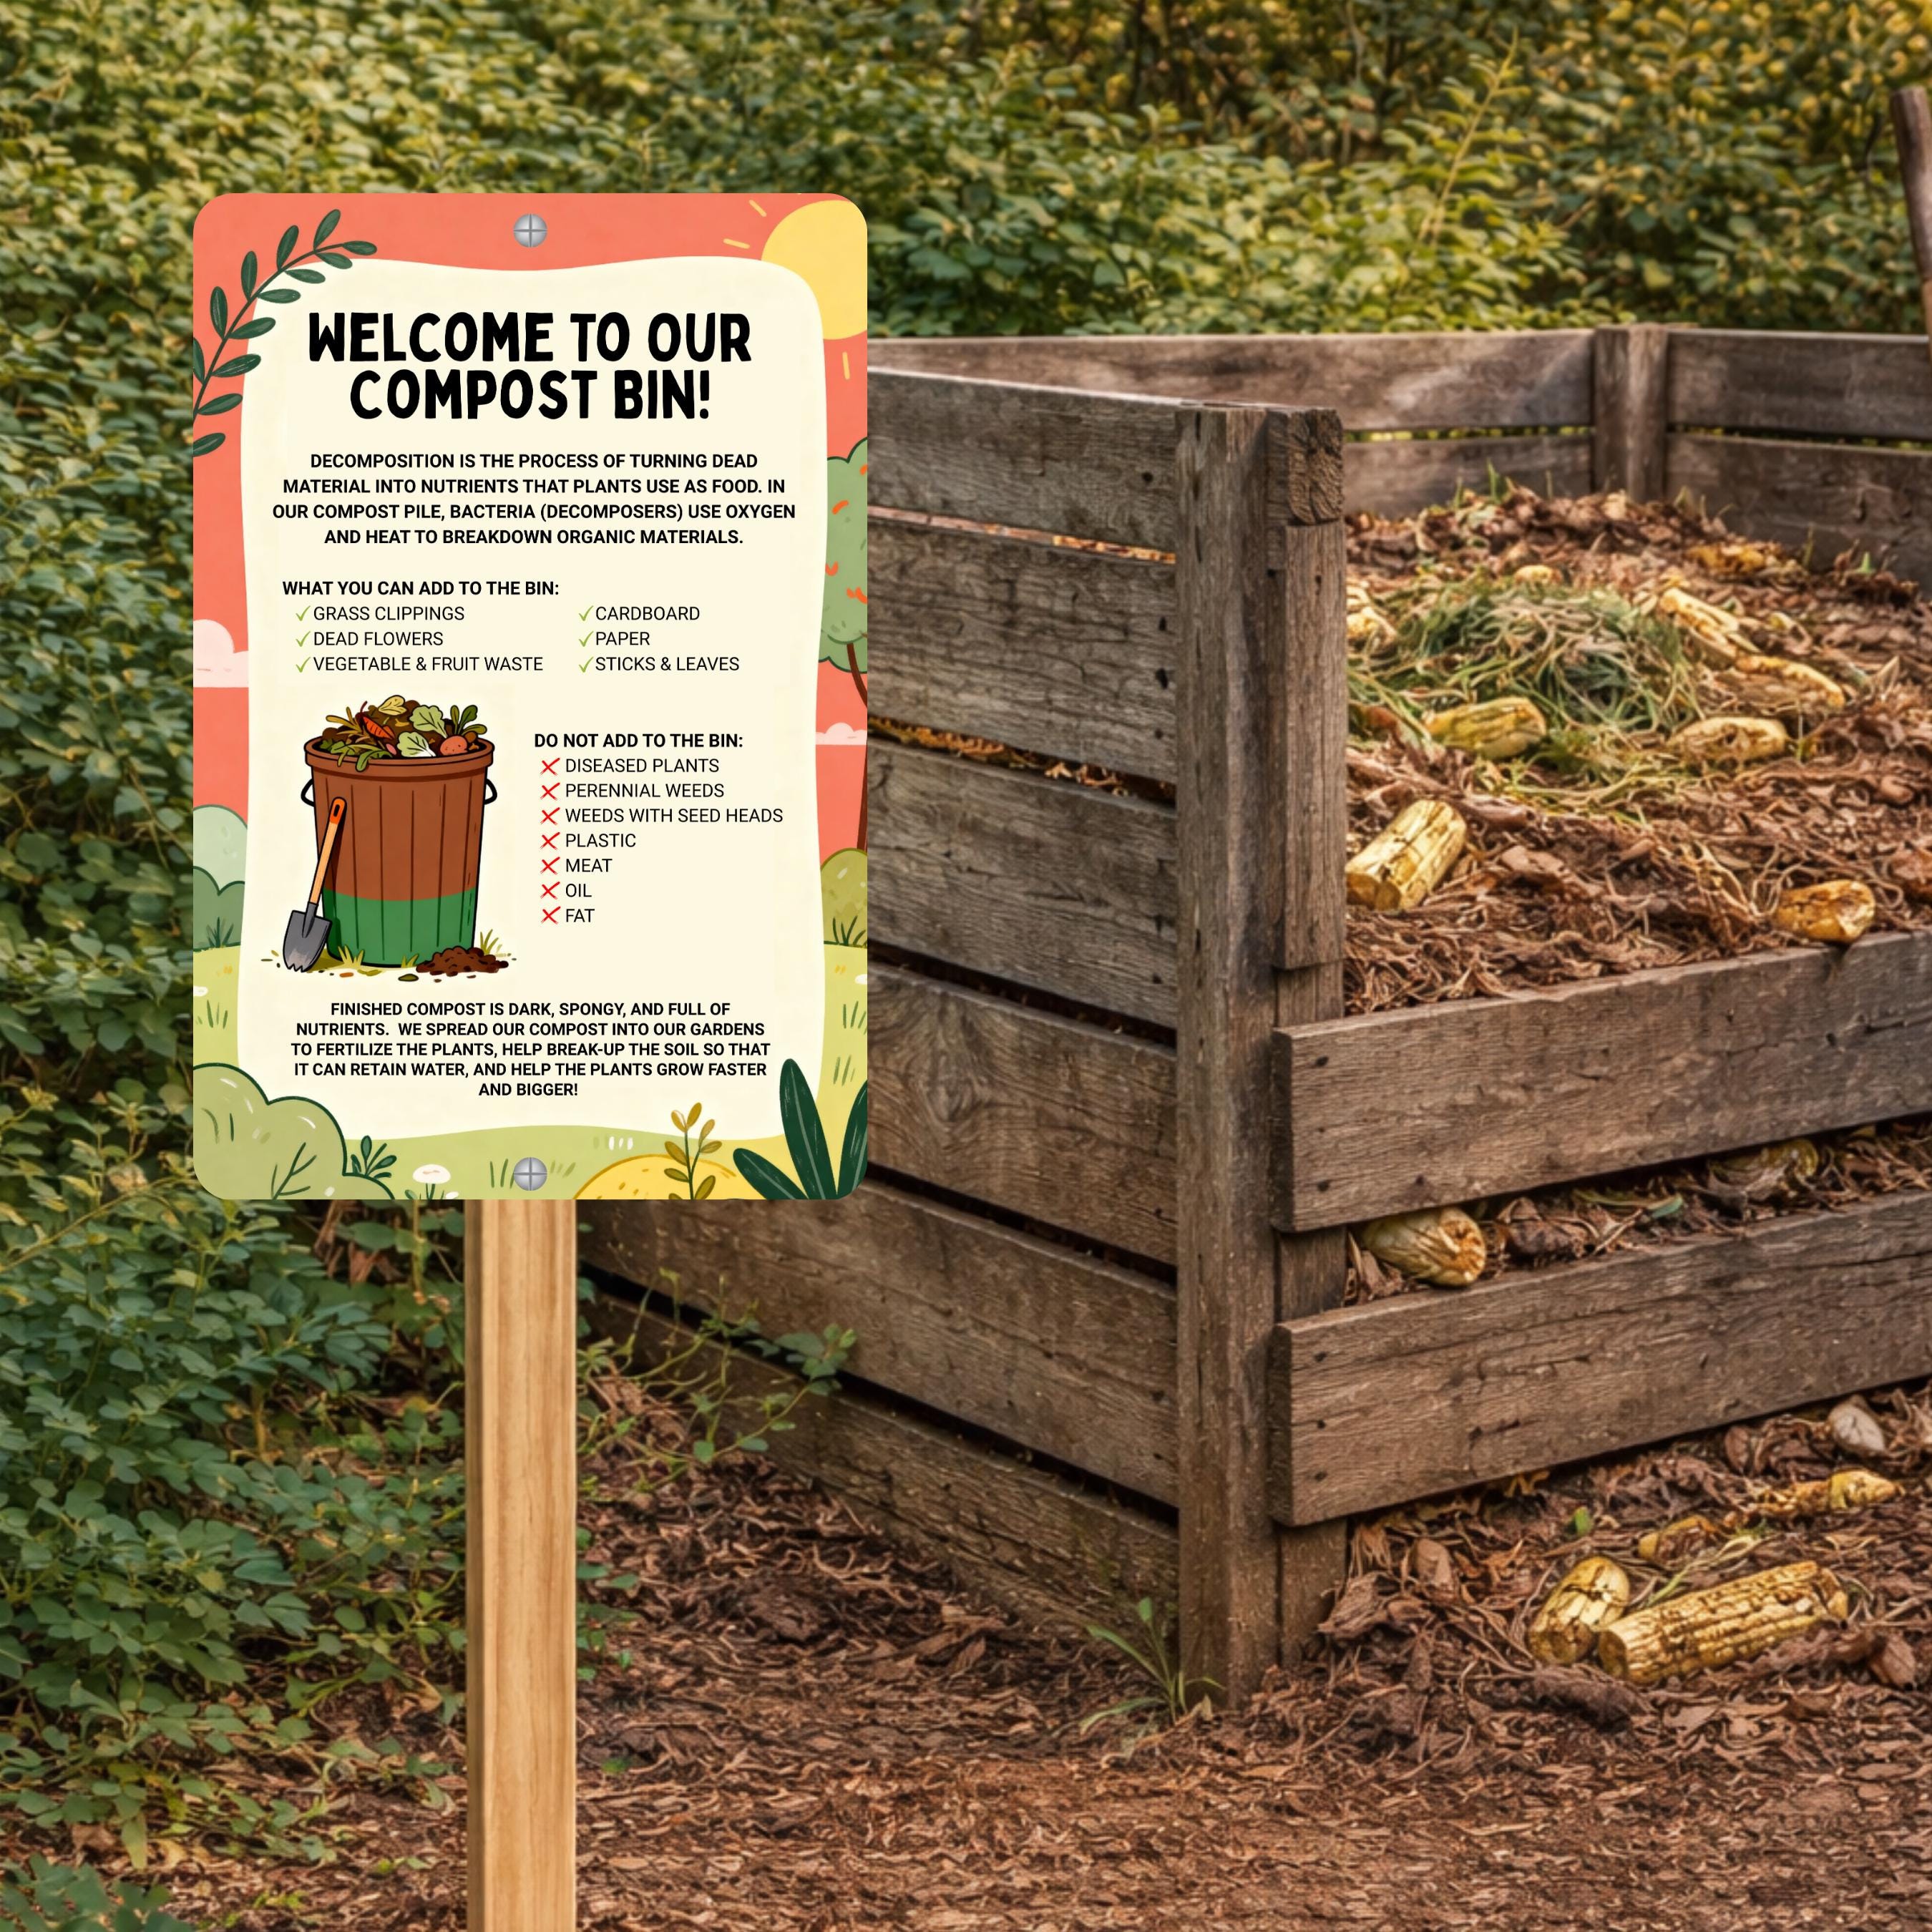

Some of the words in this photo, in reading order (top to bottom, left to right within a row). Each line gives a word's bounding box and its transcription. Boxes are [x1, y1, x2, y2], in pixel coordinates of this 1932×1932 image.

[308, 311, 554, 363] WELCOME
[570, 311, 630, 362] TO
[648, 312, 752, 363] OUR
[350, 369, 597, 420] COMPOST
[614, 369, 710, 419] BIN!
[311, 454, 454, 468] DECOMPOSITION
[460, 454, 476, 468] IS
[479, 454, 514, 468] THE
[519, 454, 598, 468] PROCESS
[603, 454, 625, 468] OF
[629, 454, 707, 468] TURNING
[713, 454, 758, 468] DEAD
[283, 479, 371, 493] MATERIAL
[376, 479, 416, 494] INTO
[421, 479, 519, 494] NUTRIENTS
[522, 479, 570, 493] THAT
[573, 479, 642, 494] PLANTS
[646, 479, 680, 494] USE
[683, 479, 707, 494] AS
[712, 479, 762, 494] FOOD.
[768, 479, 785, 493] IN
[273, 504, 308, 519] OUR
[313, 504, 400, 519] COMPOST
[404, 504, 445, 522] PILE,
[450, 504, 536, 519] BACTERIA
[540, 503, 683, 522] (DECOMPOSERS)
[688, 504, 721, 519] USE
[726, 504, 796, 519] OXYGEN
[323, 530, 361, 544] AND
[366, 530, 411, 544] HEAT
[414, 530, 438, 544] TO
[443, 530, 552, 544] BREAKDOWN
[557, 530, 635, 544] ORGANIC
[640, 530, 743, 544] MATERIALS.
[282, 581, 334, 595] WHAT
[337, 581, 373, 595] YOU
[377, 581, 414, 595] CAN
[419, 581, 454, 595] ADD
[458, 581, 482, 595] TO
[486, 581, 520, 595] THE
[525, 581, 559, 595] BIN:
[313, 606, 370, 620] GRASS
[375, 606, 464, 620] CLIPPINGS
[595, 606, 700, 620] CARDBOARD
[314, 631, 358, 646] DEAD
[364, 631, 444, 646] FLOWERS
[596, 631, 650, 645] PAPER
[313, 656, 411, 671] VEGETABLE
[416, 656, 426, 671] &
[432, 656, 480, 671] FRUIT
[484, 656, 543, 671] WASTE
[595, 656, 655, 671] STICKS
[660, 656, 671, 671] &
[676, 656, 740, 671] LEAVES
[535, 733, 558, 748] DO
[563, 733, 599, 748] NOT
[602, 733, 638, 748] ADD
[642, 733, 666, 748] TO
[669, 733, 704, 748] THE
[709, 733, 743, 748] BIN:
[566, 758, 647, 773] DISEASED
[653, 758, 719, 773] PLANTS
[566, 784, 661, 798] PERENNIAL
[665, 783, 724, 798] WEEDS
[565, 808, 625, 823] WEEDS
[628, 808, 673, 823] WITH
[678, 808, 721, 823] SEED
[726, 808, 784, 823] HEADS
[566, 833, 636, 848] PLASTIC
[566, 858, 613, 872] MEAT
[565, 883, 592, 898] OIL
[566, 908, 595, 923] FAT
[331, 1002, 403, 1016] FINISHED
[406, 1002, 486, 1016] COMPOST
[490, 1002, 504, 1016] IS
[509, 1002, 555, 1018] DARK,
[559, 1002, 626, 1018] SPONGY,
[630, 1002, 664, 1015] AND
[668, 1002, 706, 1016] FULL
[710, 1002, 731, 1016] OF
[296, 1023, 389, 1036] NUTRIENTS.
[398, 1023, 422, 1036] WE
[426, 1023, 488, 1036] SPREAD
[492, 1023, 525, 1036] OUR
[529, 1023, 608, 1036] COMPOST
[612, 1023, 649, 1036] INTO
[653, 1023, 686, 1036] OUR
[690, 1023, 765, 1036] GARDENS
[291, 1043, 312, 1056] TO
[316, 1043, 393, 1056] FERTILIZE
[396, 1043, 428, 1056] THE
[431, 1043, 497, 1058] PLANTS,
[502, 1043, 542, 1056] HELP
[547, 1043, 625, 1056] BREAK-UP
[628, 1043, 660, 1056] THE
[664, 1043, 699, 1056] SOIL
[703, 1043, 725, 1056] SO
[728, 1043, 771, 1056] THAT
[295, 1063, 309, 1076] IT
[312, 1063, 346, 1076] CAN
[351, 1063, 406, 1076] RETAIN
[411, 1063, 469, 1078] WATER,
[473, 1063, 507, 1076] AND
[511, 1063, 552, 1076] HELP
[555, 1063, 586, 1076] THE
[590, 1063, 653, 1076] PLANTS
[656, 1063, 704, 1076] GROW
[708, 1063, 767, 1076] FASTER
[478, 1083, 512, 1096] AND
[517, 1083, 578, 1096] BIGGER!
